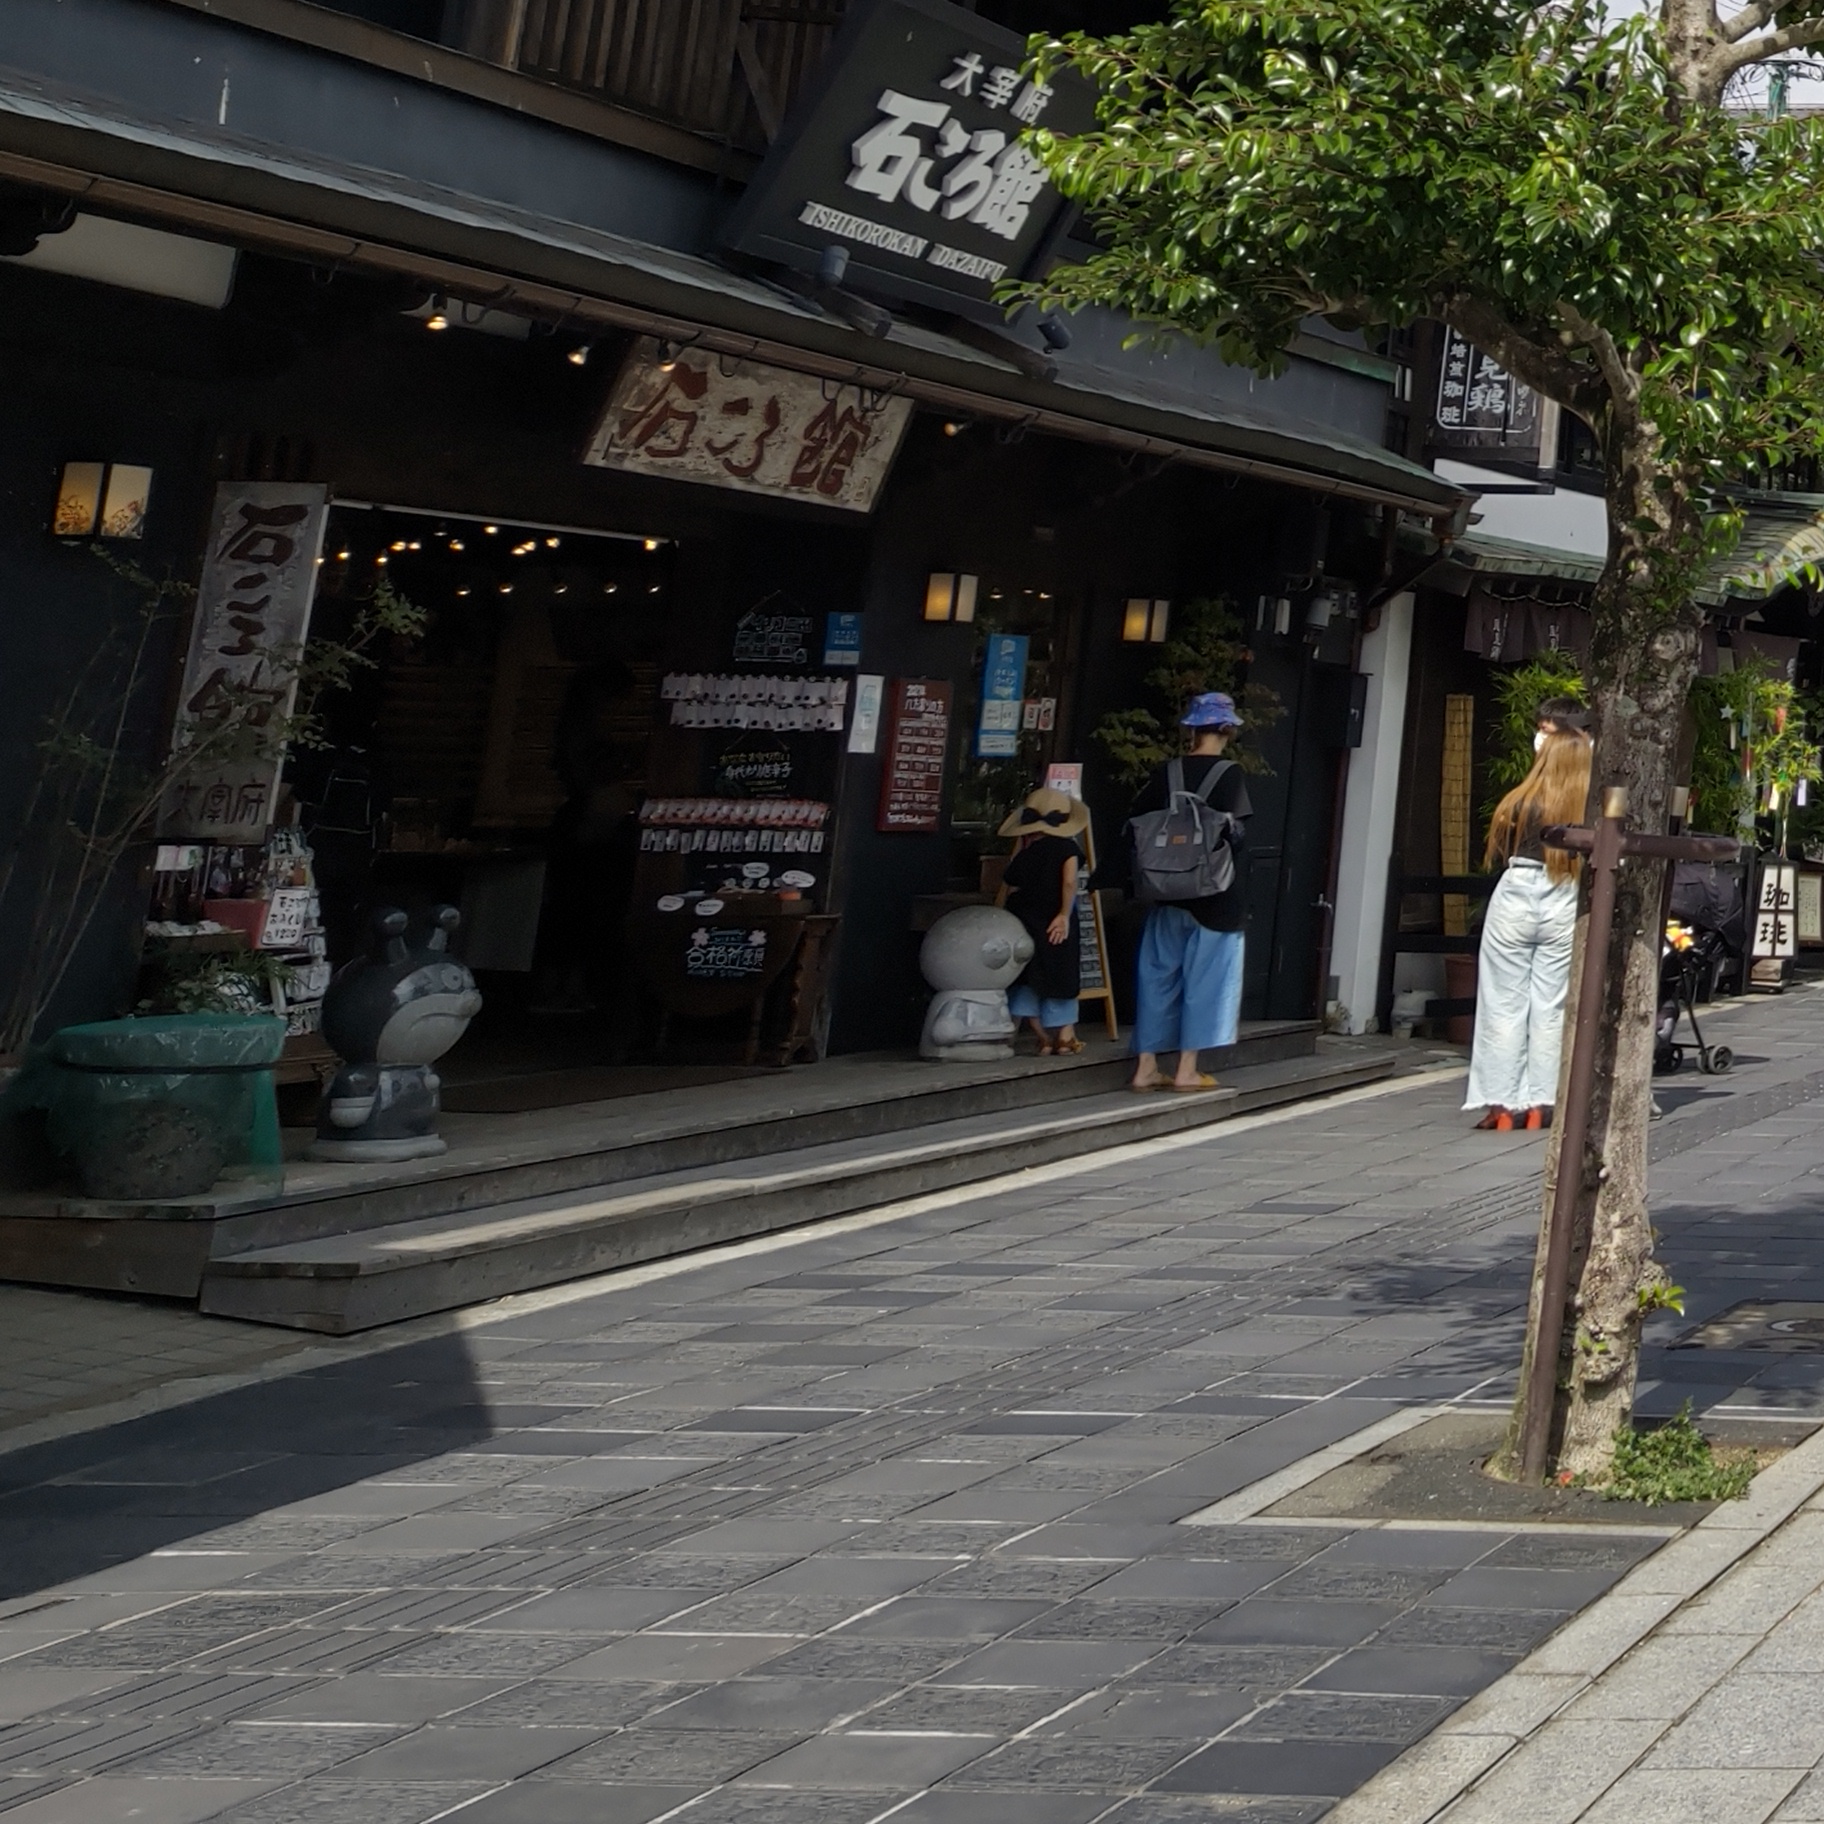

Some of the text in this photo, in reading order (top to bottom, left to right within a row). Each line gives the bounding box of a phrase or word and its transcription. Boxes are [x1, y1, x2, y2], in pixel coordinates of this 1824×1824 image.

[845, 87, 1051, 241] 石ころ館
[800, 200, 1008, 283] ISHIKOROKAN DAZAIFU
[619, 362, 872, 497] 石ころ館
[1759, 883, 1790, 946] 珈琲
